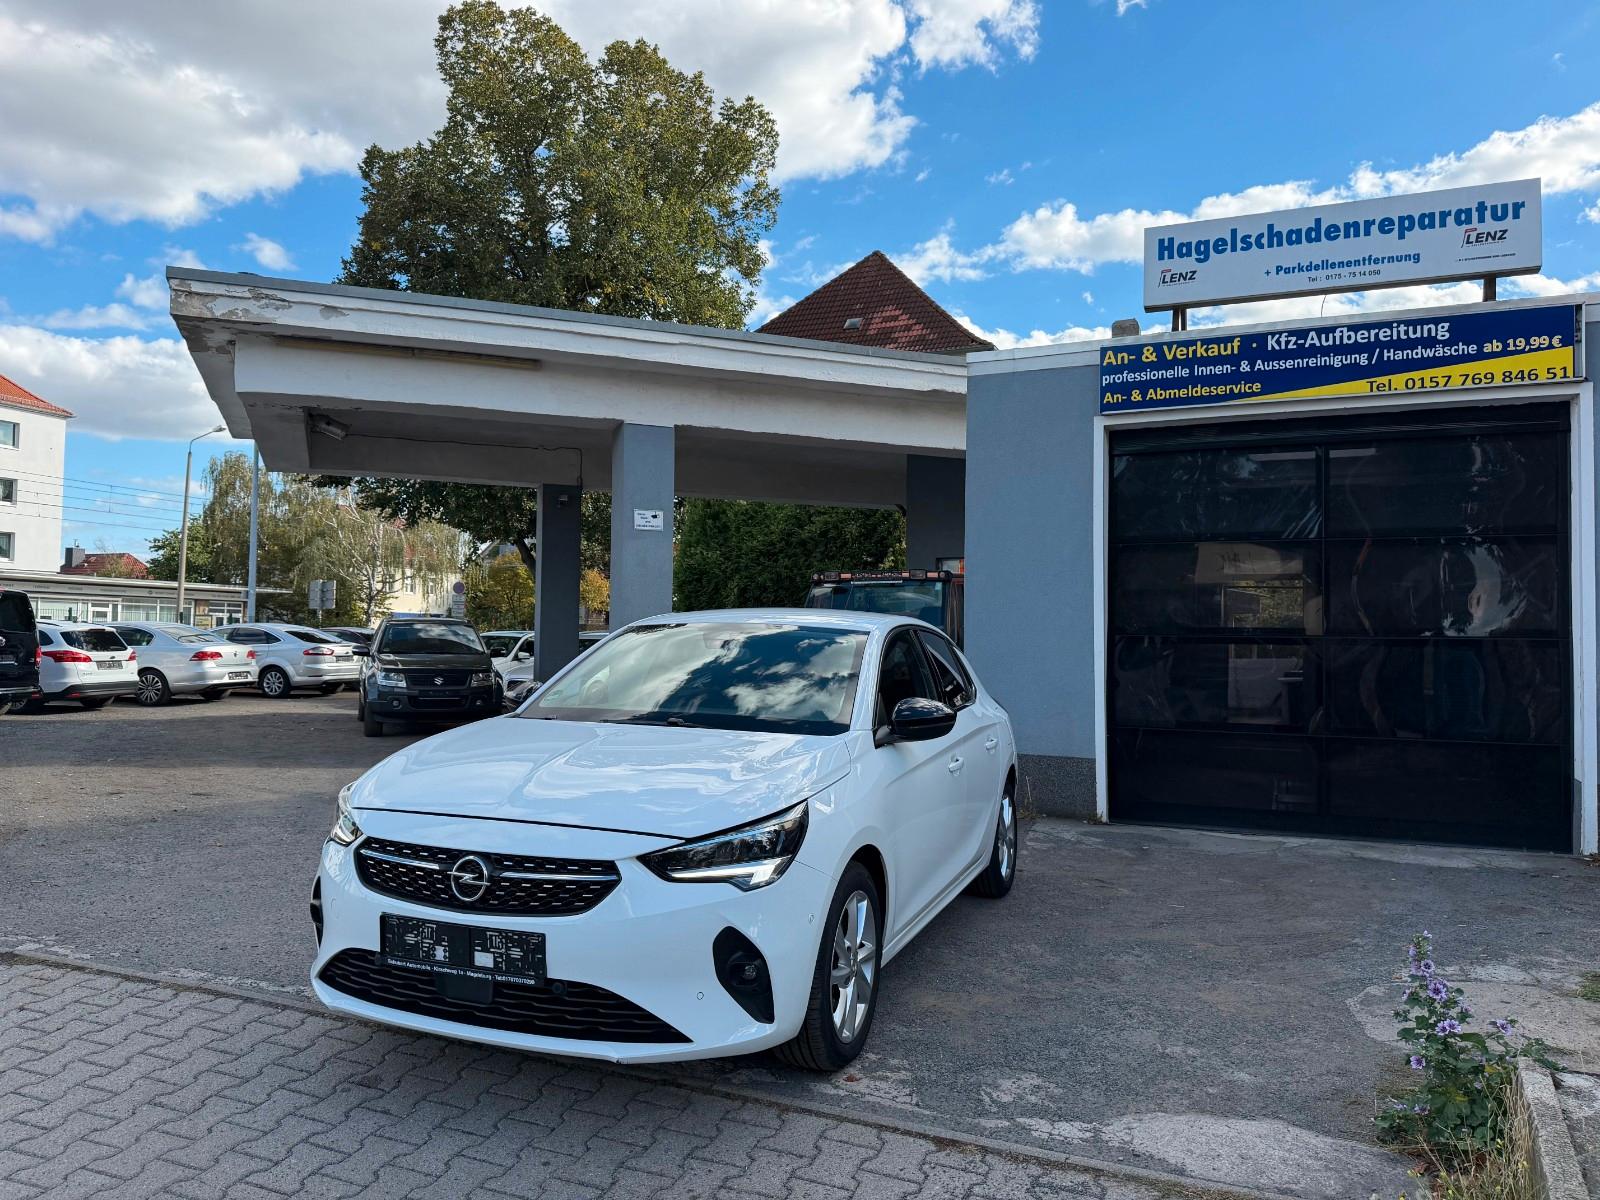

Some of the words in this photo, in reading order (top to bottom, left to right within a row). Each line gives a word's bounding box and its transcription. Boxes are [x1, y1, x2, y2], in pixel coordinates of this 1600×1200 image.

[1157, 200, 1526, 264] Hagelschadenreparatur
[1464, 228, 1509, 245] LENZ
[1161, 270, 1198, 285] LENZ
[1264, 268, 1272, 277] +
[1275, 252, 1421, 276] Parkdellenentfernung
[1102, 350, 1136, 366] An-
[1141, 345, 1157, 363] &
[1163, 337, 1241, 361] Verkauf
[1267, 322, 1450, 351] Kfz-Aufbereitung
[1102, 365, 1190, 387] professionelle
[1194, 363, 1236, 376] Innen-
[1239, 360, 1251, 372] &
[1254, 352, 1369, 371] Aussenreinigung
[1383, 341, 1478, 361] Handwäsche
[1483, 339, 1503, 353] ab
[1103, 392, 1127, 404] An-
[1131, 389, 1143, 402] &
[1146, 380, 1262, 400] Abmeldeservice
[1366, 379, 1398, 393] Tel.
[1404, 375, 1453, 390] 0157
[1459, 372, 1495, 386] 769
[1501, 368, 1539, 383] 846
[1546, 366, 1570, 379] 51
